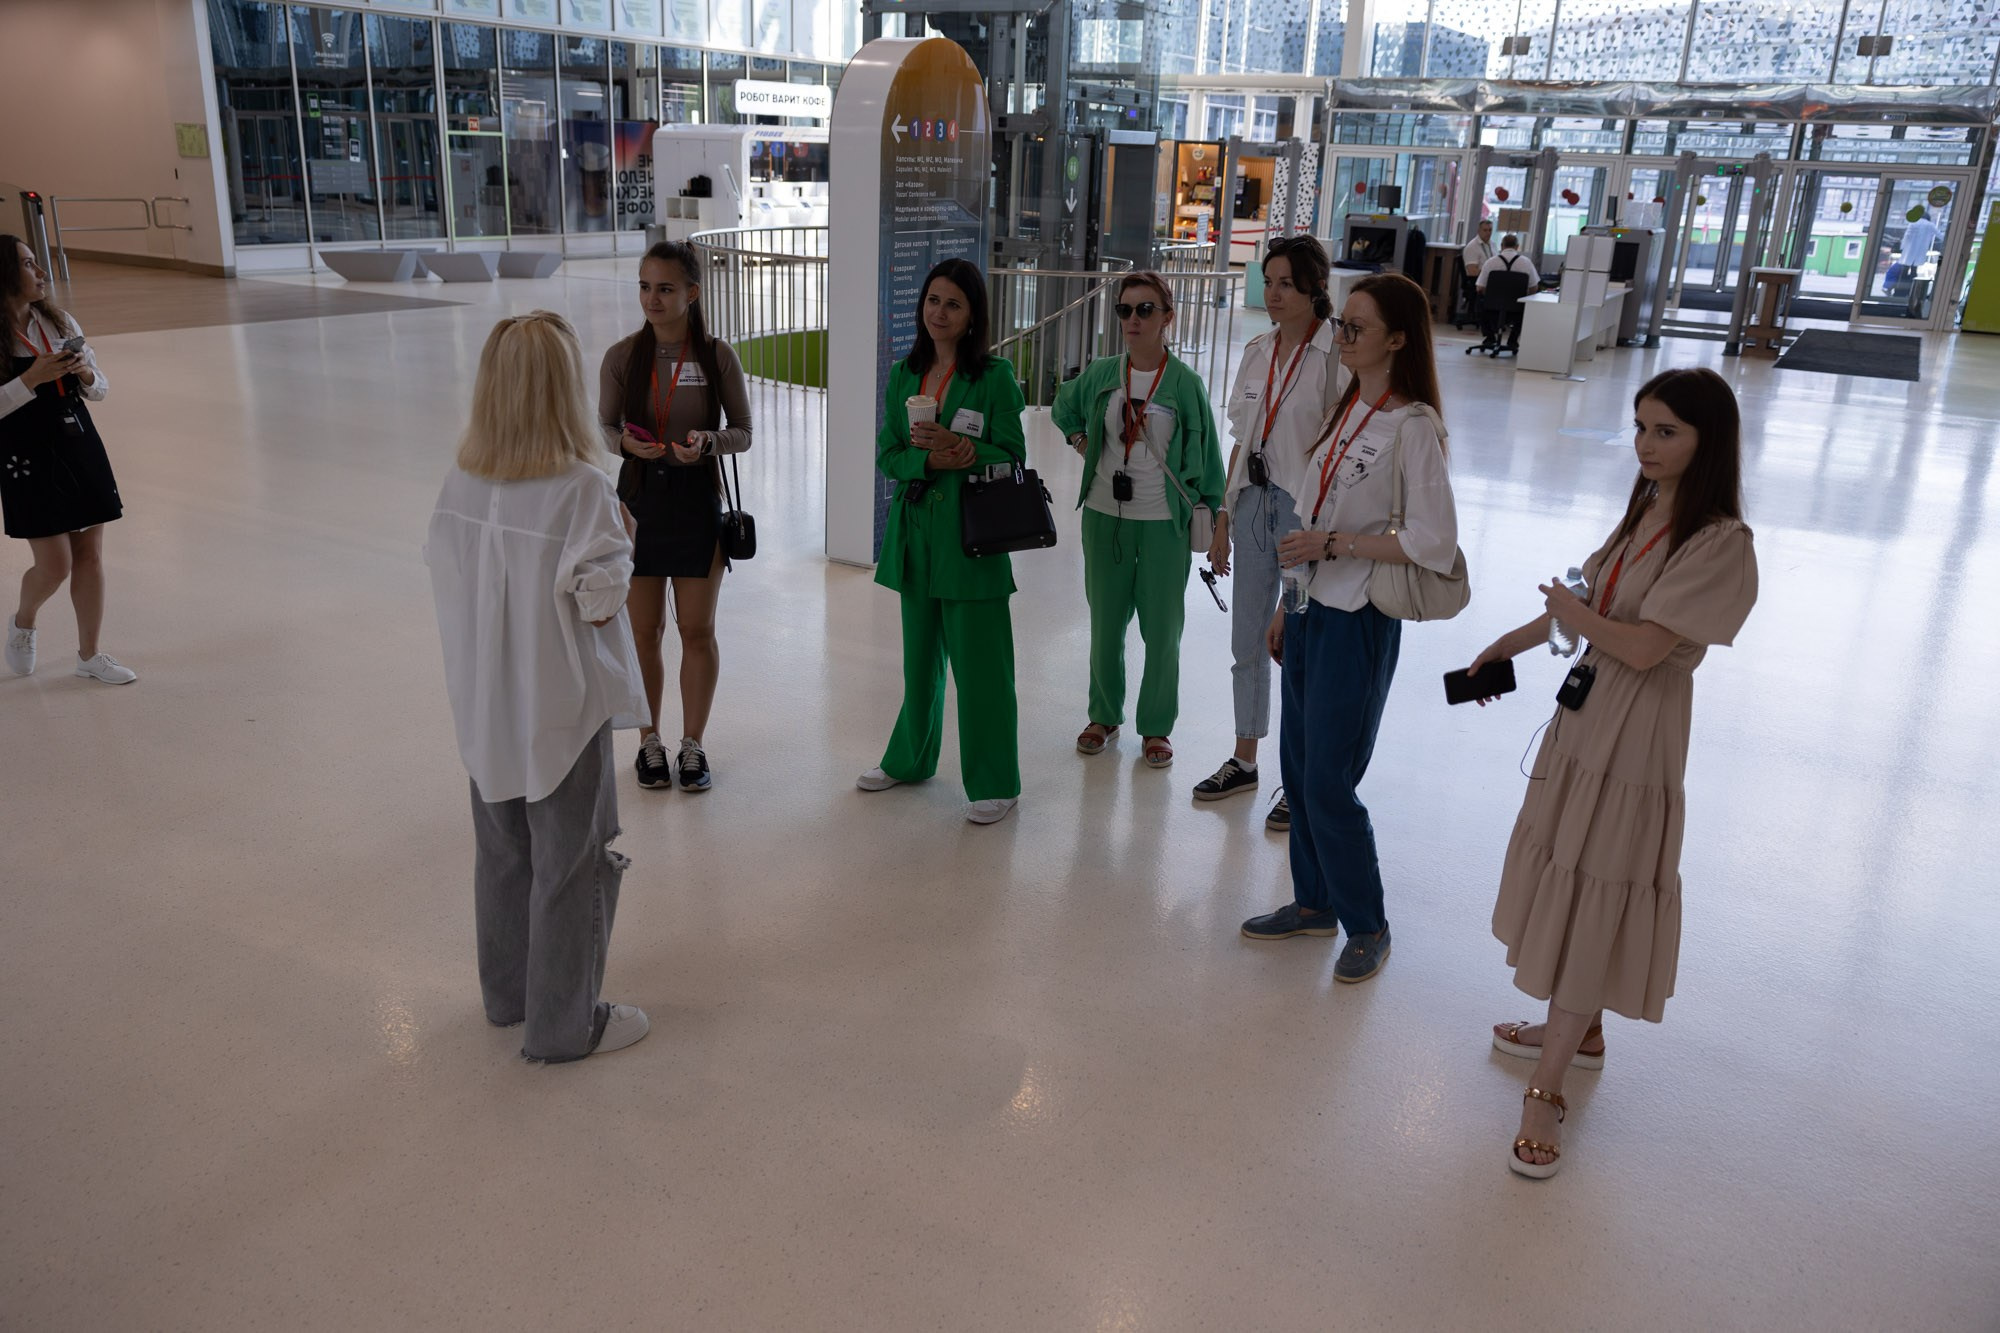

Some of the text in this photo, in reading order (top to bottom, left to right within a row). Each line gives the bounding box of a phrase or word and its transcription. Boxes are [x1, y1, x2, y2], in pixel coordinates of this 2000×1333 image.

[740, 91, 825, 106] РОБОТ ВАРИТ КОФЕ
